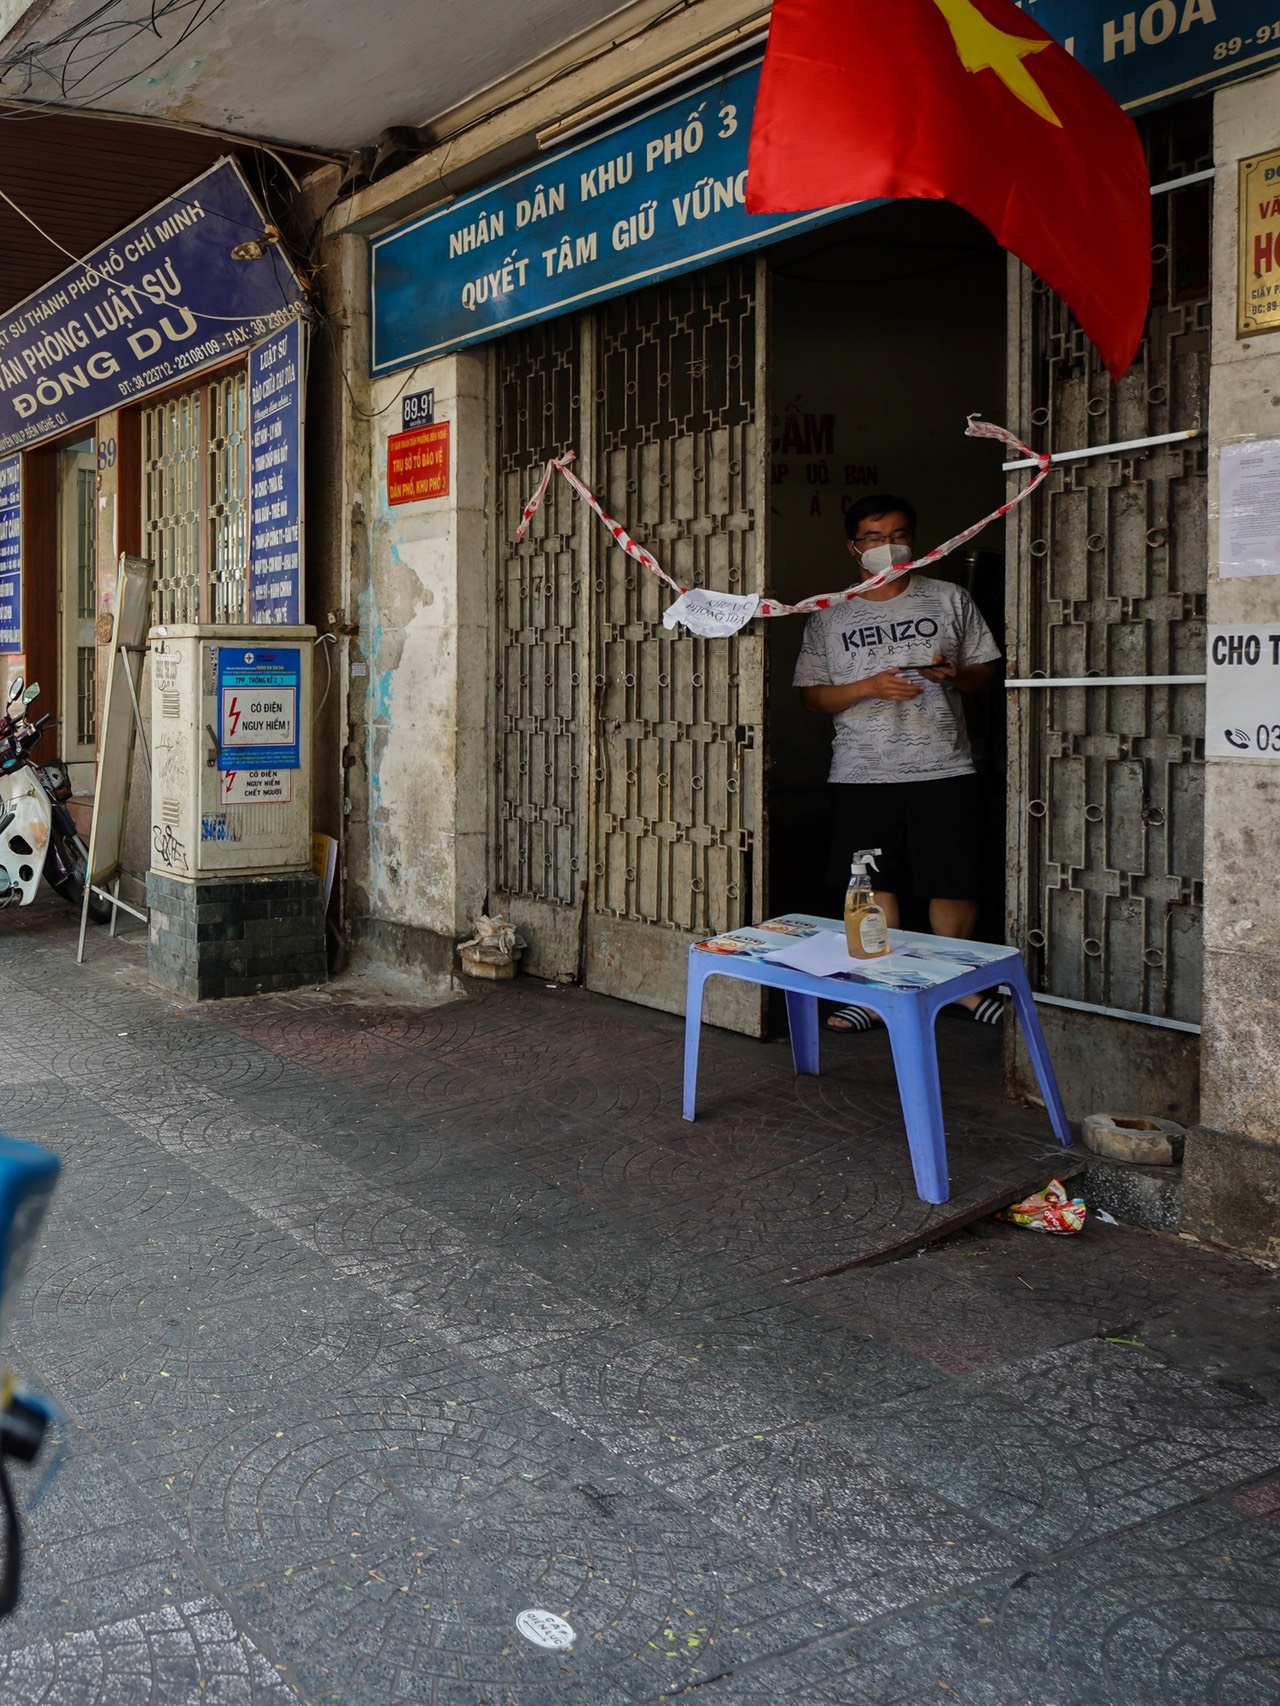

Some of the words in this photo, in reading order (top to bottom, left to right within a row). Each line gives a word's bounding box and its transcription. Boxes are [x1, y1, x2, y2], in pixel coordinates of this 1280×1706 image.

[449, 211, 504, 259] NHÂN
[515, 184, 565, 231] DÂN
[580, 151, 634, 202] KHU
[646, 101, 708, 172] PHỐ
[717, 104, 738, 139] 3
[9, 316, 27, 338] SƯ
[25, 291, 69, 327] THÀNH
[67, 263, 100, 299] PHỐ
[98, 248, 124, 278] HỒ
[124, 227, 156, 262] CHÍ
[154, 200, 206, 243] MINH
[461, 248, 529, 310] QUYẾT
[542, 233, 598, 277] TÂM
[612, 200, 658, 252] GIỮ
[22, 320, 90, 375] PHÒNG
[84, 284, 143, 339] LUẬT
[142, 256, 181, 305] SƯ
[224, 326, 252, 347] FAX:
[11, 351, 121, 419] ĐÔNG
[126, 306, 198, 361] DU
[98, 438, 116, 470] 89
[842, 618, 938, 652] KENZO
[1212, 635, 1261, 666] CHO
[242, 721, 264, 731] NGUY
[266, 717, 286, 730] HIỂM
[250, 701, 261, 713] CÓ
[263, 701, 282, 714] ĐIỆN
